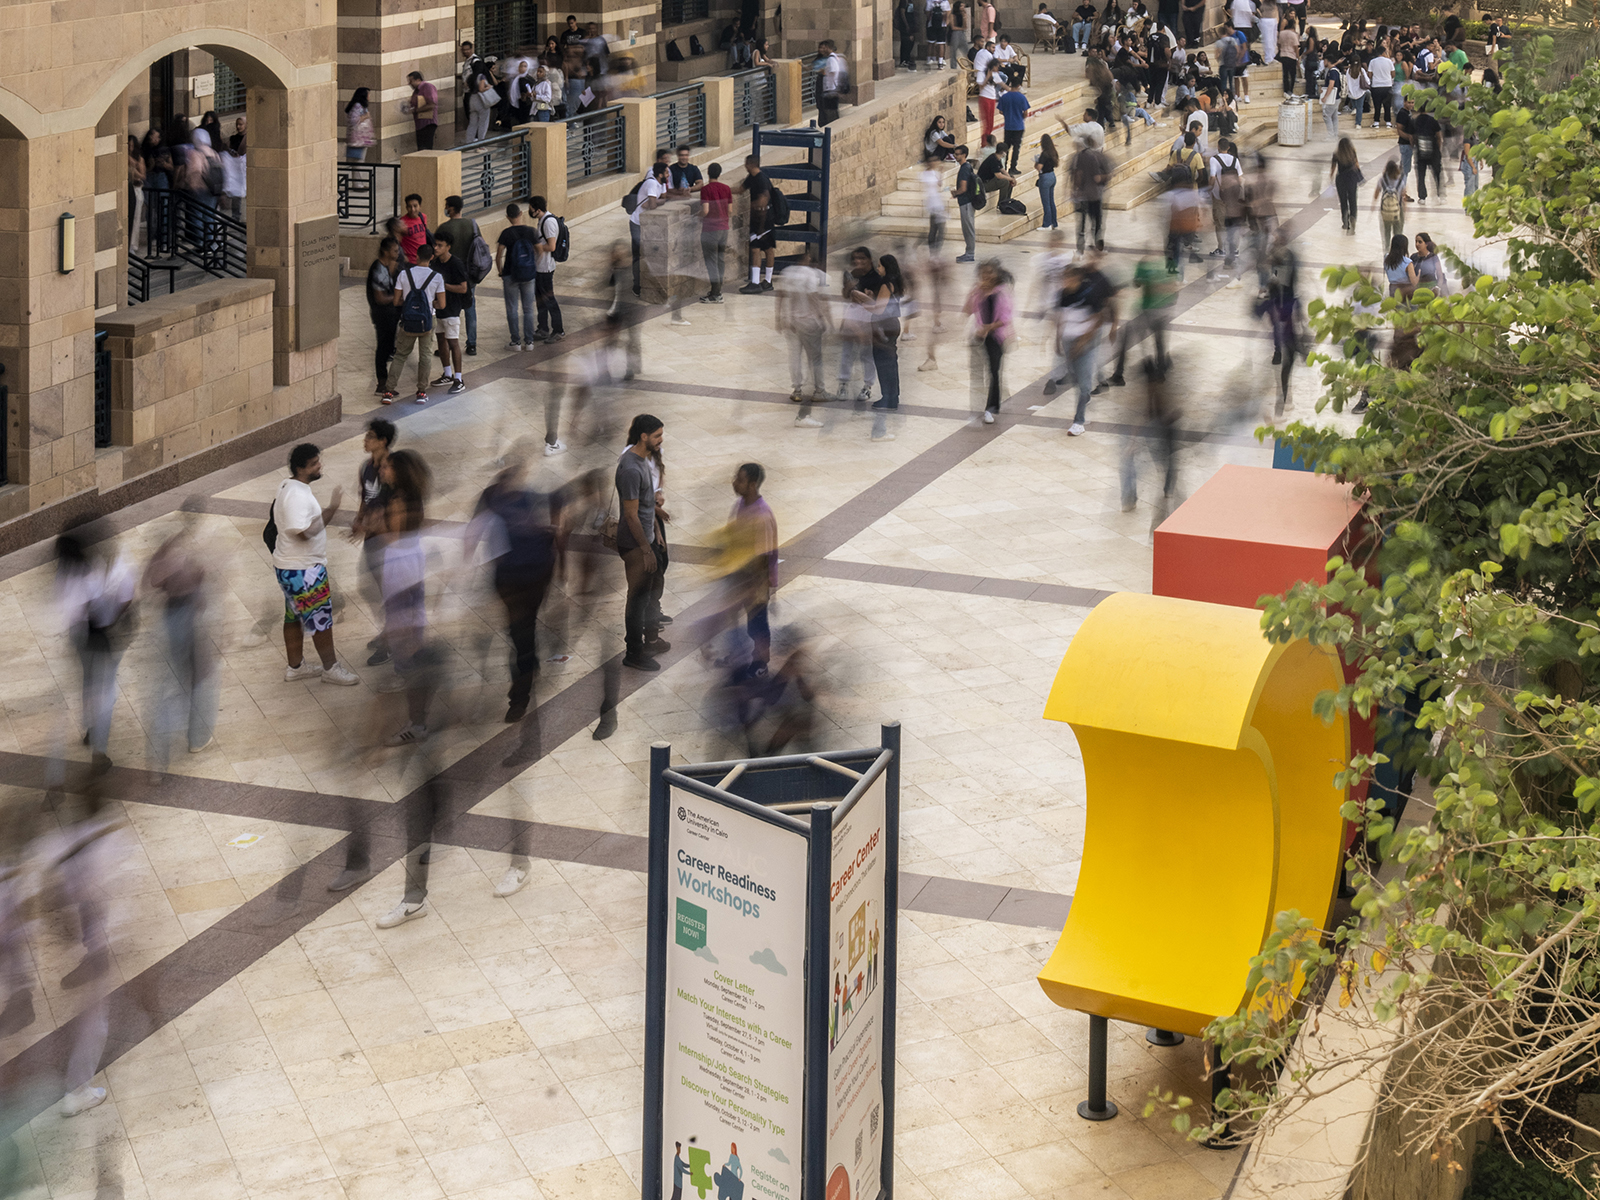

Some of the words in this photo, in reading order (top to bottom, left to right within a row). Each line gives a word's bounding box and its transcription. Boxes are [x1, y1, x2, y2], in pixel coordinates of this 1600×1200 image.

[686, 818, 710, 832] University
[716, 828, 728, 839] Cairo
[687, 809, 696, 818] The
[696, 814, 720, 827] American
[677, 849, 716, 876] Career
[718, 864, 776, 902] Readiness
[830, 859, 856, 902] Career
[856, 827, 880, 868] Center
[676, 867, 760, 918] Workshops
[677, 913, 706, 932] REGISTER
[682, 926, 700, 940] NOW!
[714, 970, 734, 986] Cover
[734, 980, 755, 996] Letter
[676, 987, 698, 1005] Match
[699, 998, 715, 1012] Your
[716, 1006, 746, 1028] Interests
[747, 1022, 762, 1036] with
[764, 1030, 768, 1038] a
[769, 1031, 792, 1050] Career
[728, 1066, 752, 1086] Search
[754, 1078, 790, 1105] Strategies
[681, 1075, 710, 1098] Discover
[711, 1090, 727, 1106] Your
[728, 1099, 767, 1128] Personality
[768, 1119, 786, 1136] Type
[750, 1164, 779, 1186] Register
[780, 1182, 790, 1192] on
